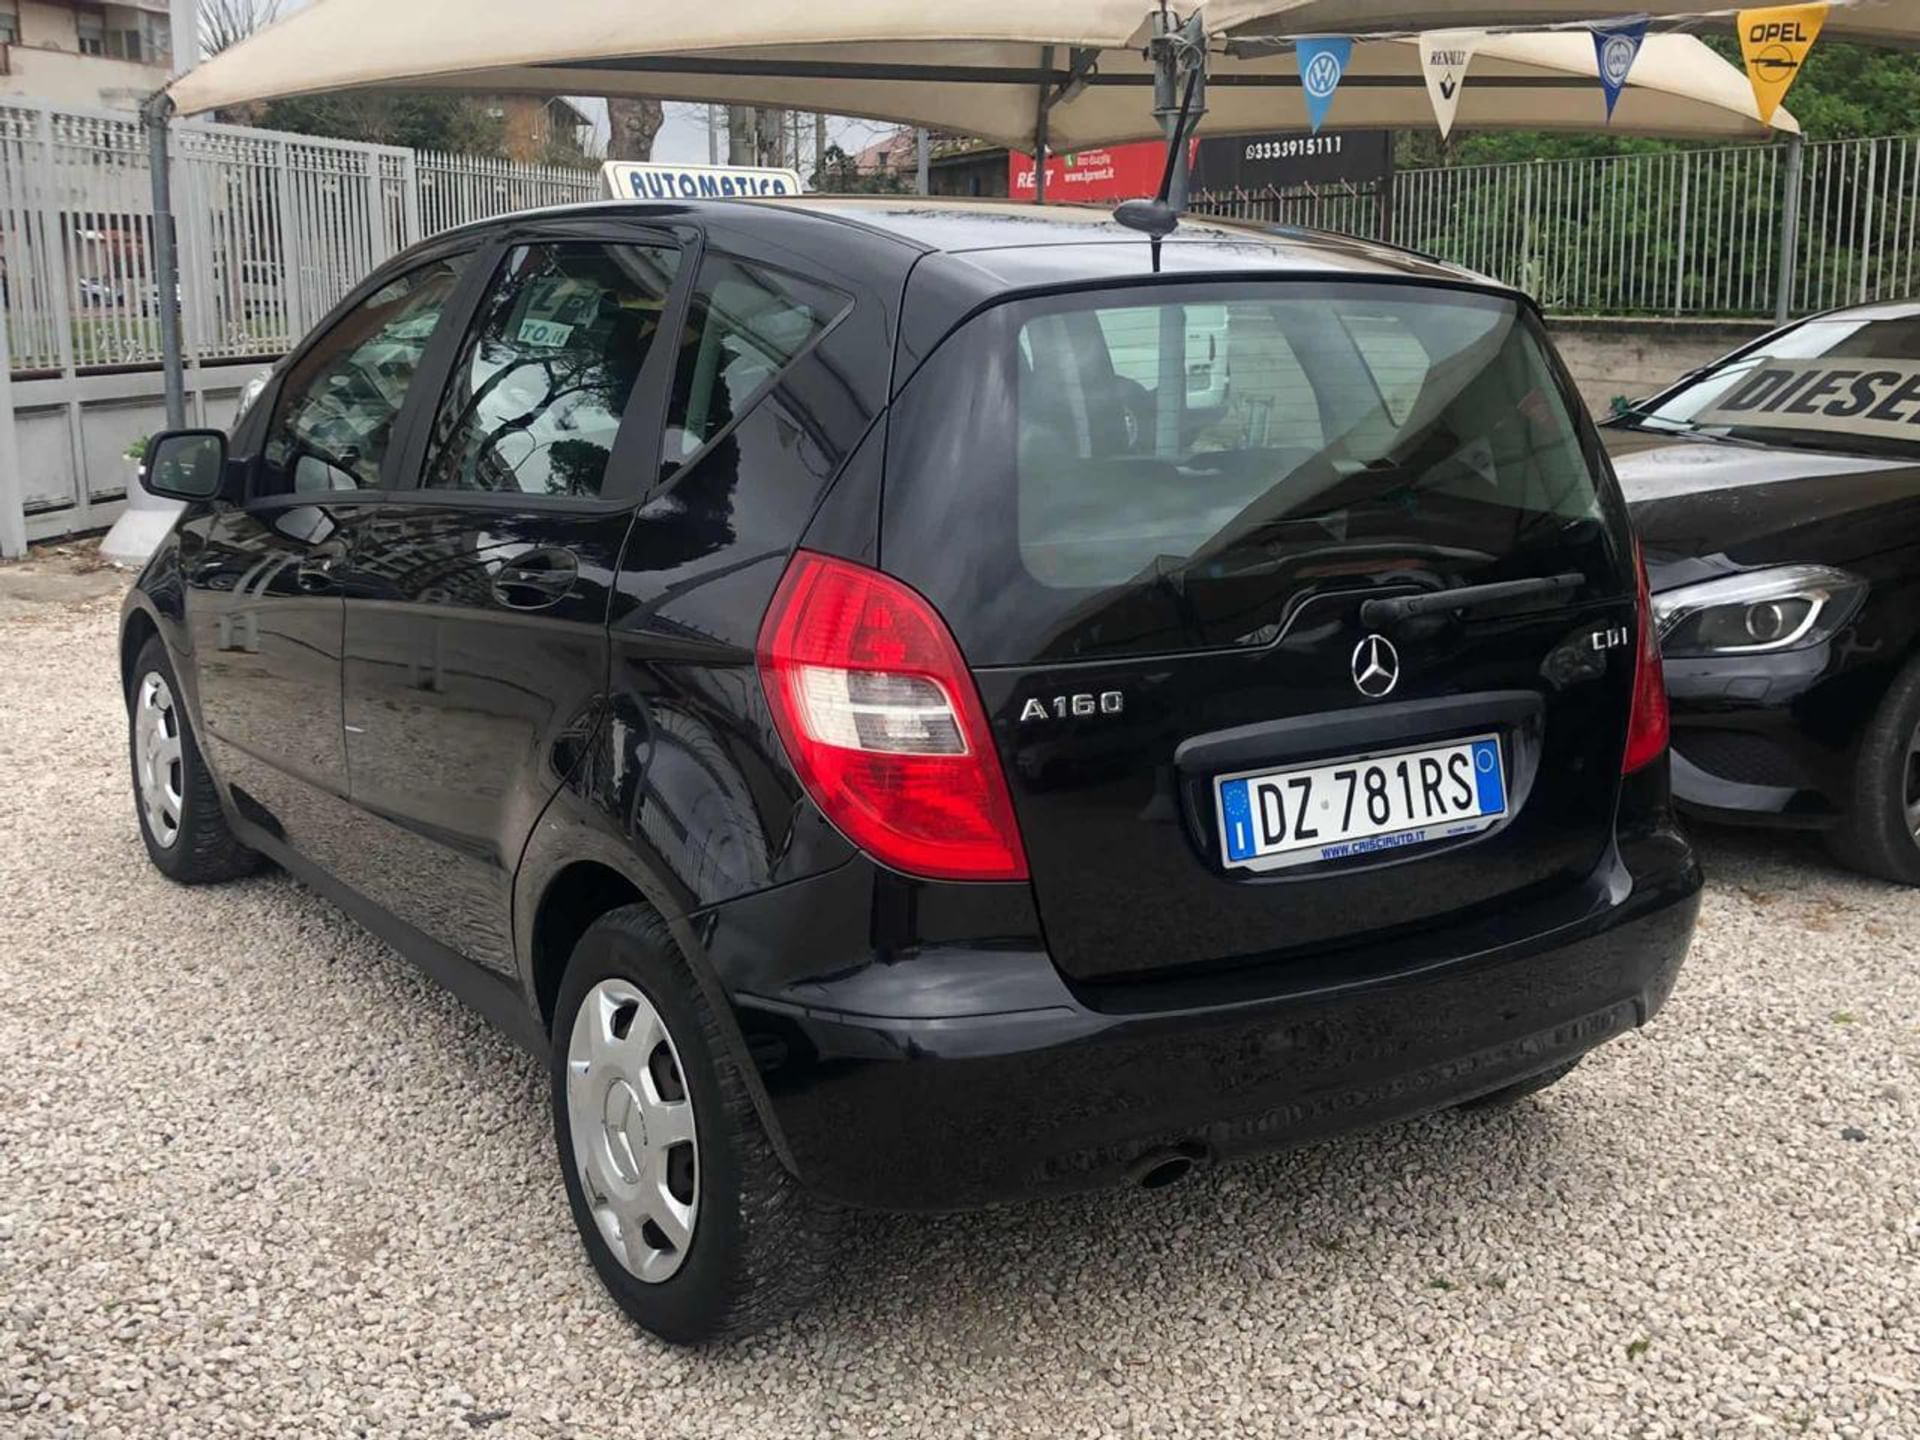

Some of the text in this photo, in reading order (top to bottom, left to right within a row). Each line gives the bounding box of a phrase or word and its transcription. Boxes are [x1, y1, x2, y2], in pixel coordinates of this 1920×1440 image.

[1750, 22, 1807, 43] OPEL
[1255, 136, 1342, 160] 3333915111
[629, 171, 787, 199] AUTOMATICA
[1017, 170, 1054, 189] RET
[1717, 370, 1920, 424] DIESE
[1592, 626, 1628, 651] CDI
[1257, 752, 1473, 846] DZ 781RS
